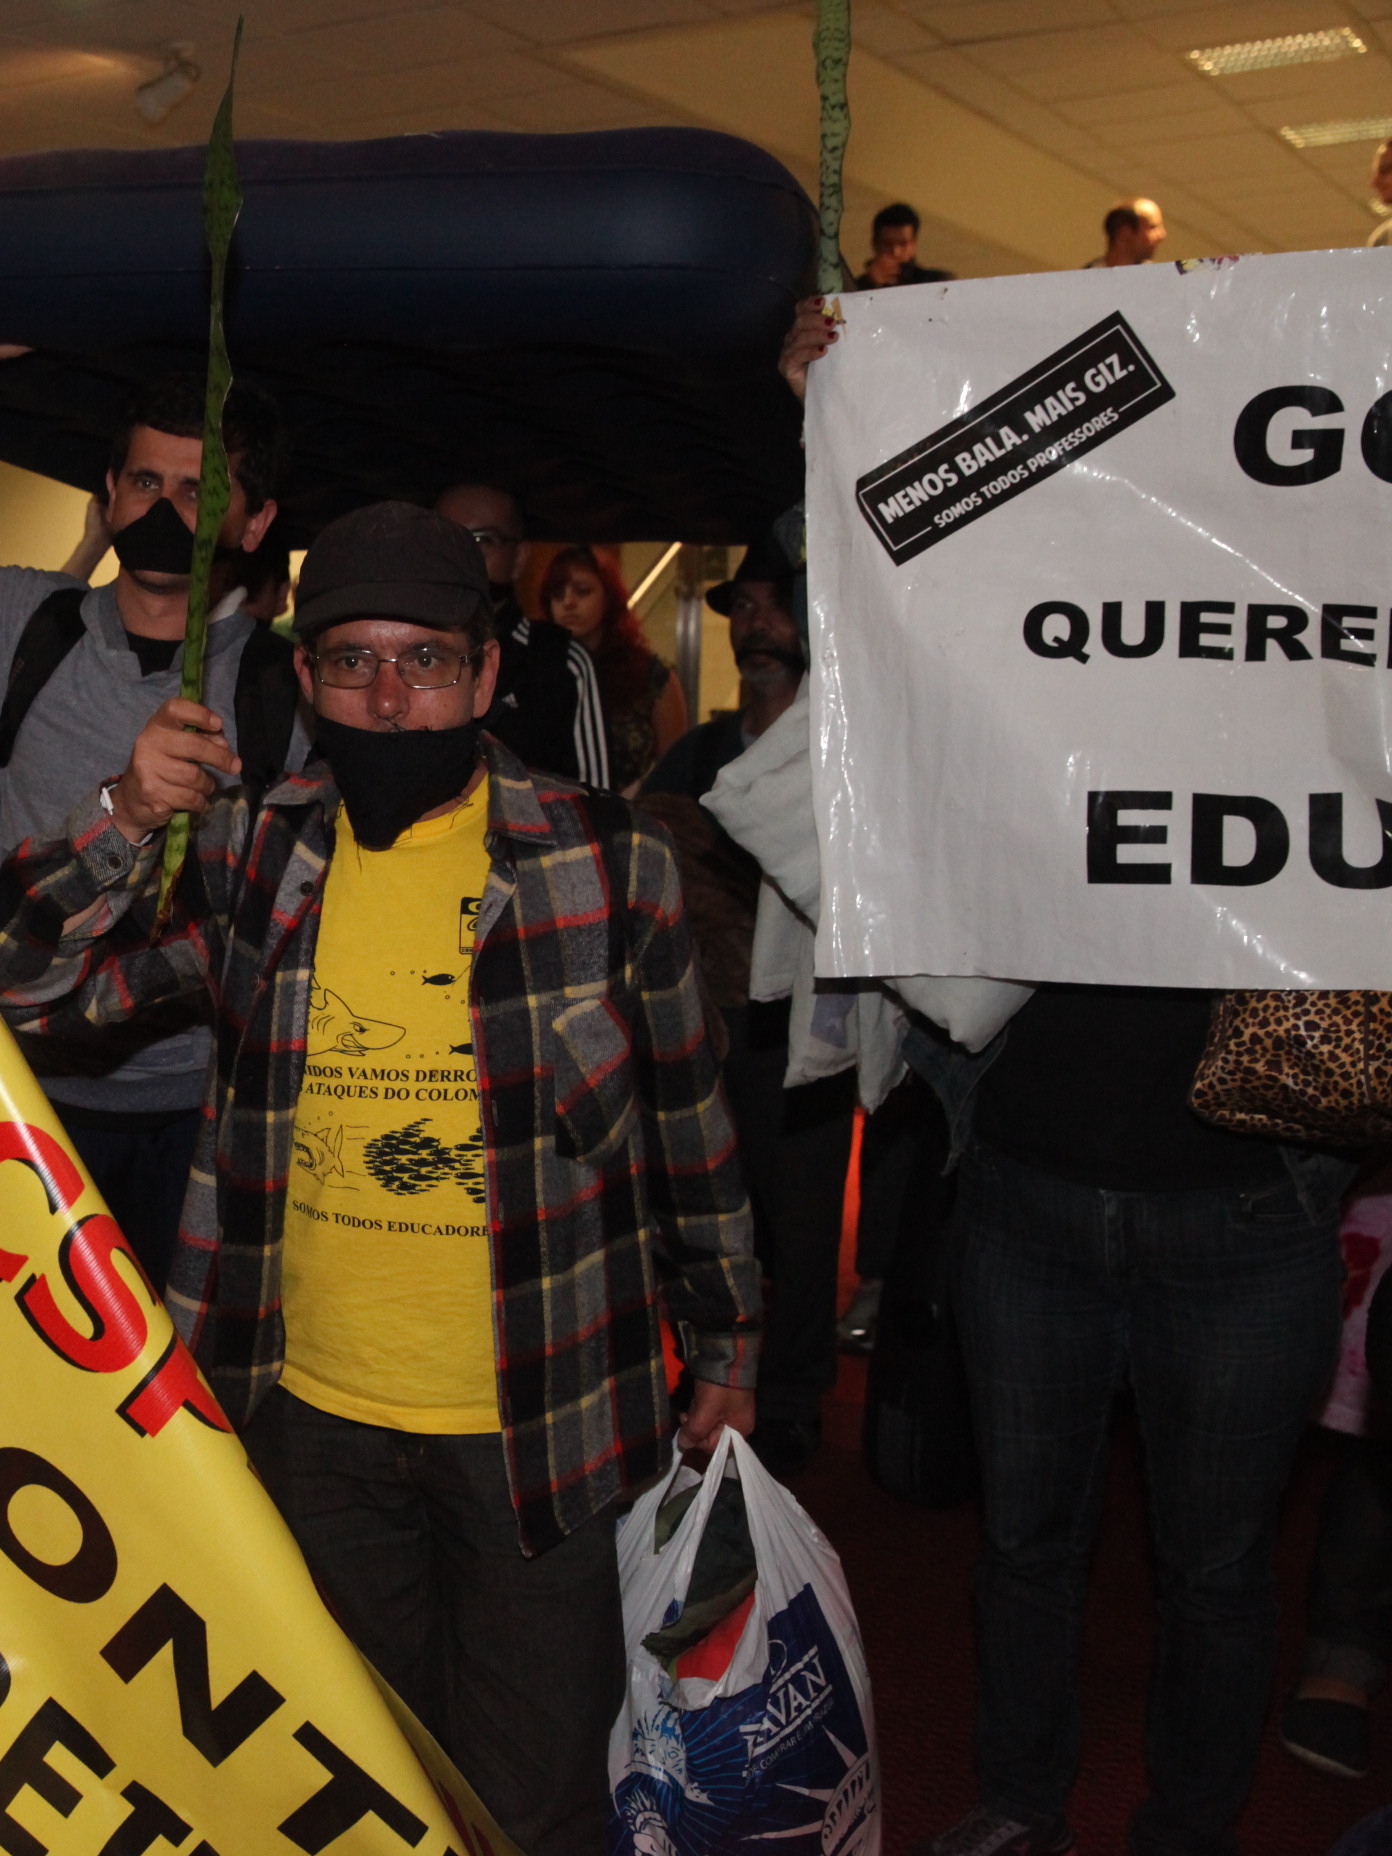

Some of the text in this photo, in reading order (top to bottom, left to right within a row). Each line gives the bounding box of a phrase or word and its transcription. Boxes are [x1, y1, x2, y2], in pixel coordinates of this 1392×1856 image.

[878, 353, 1135, 524] MENOS BALA. MAIS GIZ.
[933, 407, 1119, 528] SOMOS TODOS PROFESSORES
[1233, 385, 1392, 487] G
[1023, 600, 1392, 669] QUERE
[305, 1082, 379, 1101] ATAQUES
[383, 1086, 410, 1101] DO
[415, 1087, 480, 1102] COLOM
[347, 1066, 410, 1083] VAMOS
[414, 1069, 478, 1083] DERRO
[292, 1200, 489, 1238] SOMOS TODOS EDUCADORE
